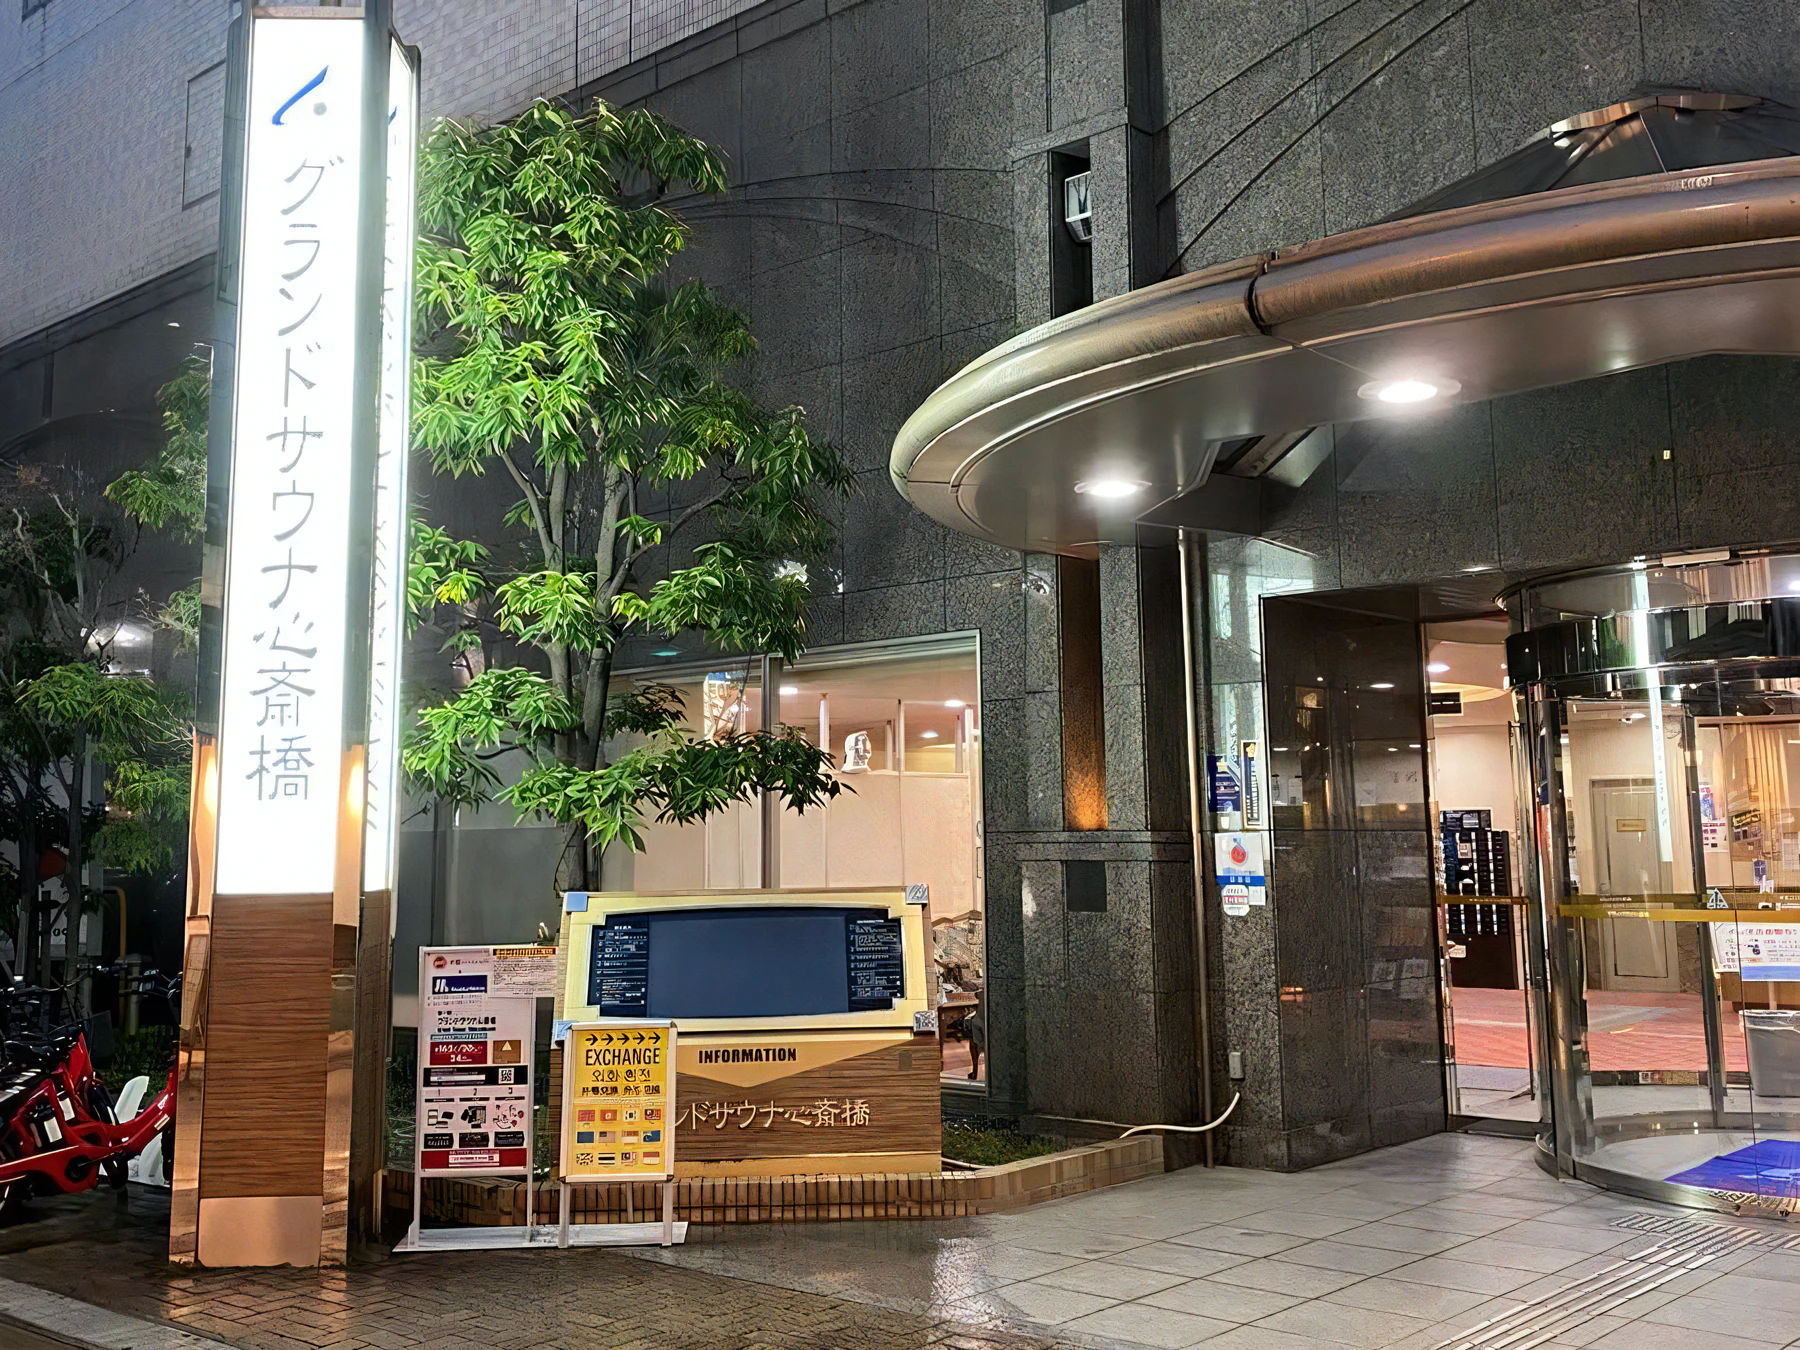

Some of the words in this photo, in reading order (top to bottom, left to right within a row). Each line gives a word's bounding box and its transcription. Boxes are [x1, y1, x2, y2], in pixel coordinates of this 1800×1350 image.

[245, 155, 345, 801] グランドサウナ心斎橋
[585, 1048, 660, 1065] EXCHANGE
[699, 1048, 797, 1064] INFORMATION
